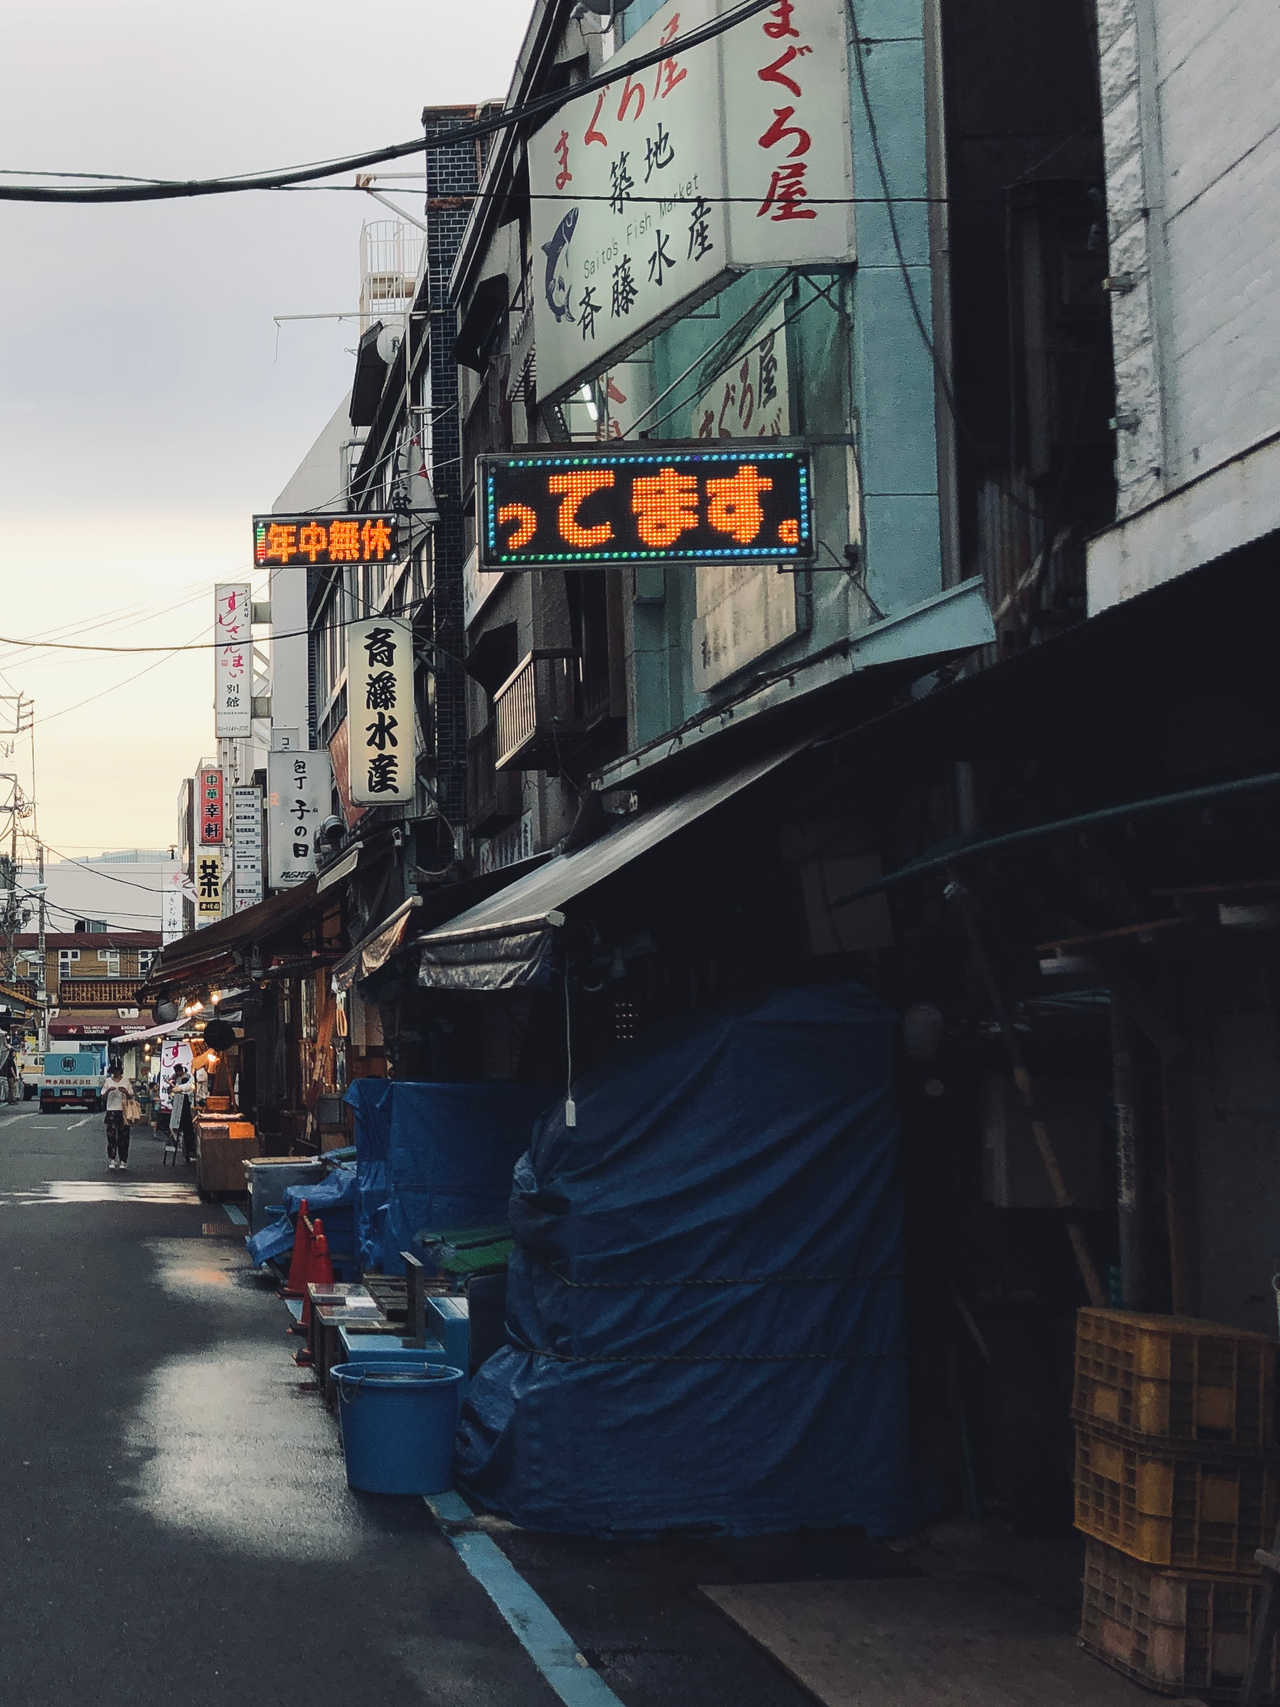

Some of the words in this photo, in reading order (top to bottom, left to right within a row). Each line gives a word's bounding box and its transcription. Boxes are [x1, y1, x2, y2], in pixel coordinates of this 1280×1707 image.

[757, 0, 817, 222] まぐろ屋
[626, 216, 652, 251] Fish
[498, 464, 801, 551] ってます。
[264, 518, 393, 562] 年中無休
[218, 590, 246, 680] すしざんまい
[225, 684, 241, 708] 別館
[293, 759, 308, 790] 包丁
[290, 799, 311, 859] 子の日
[198, 859, 221, 898] 茶
